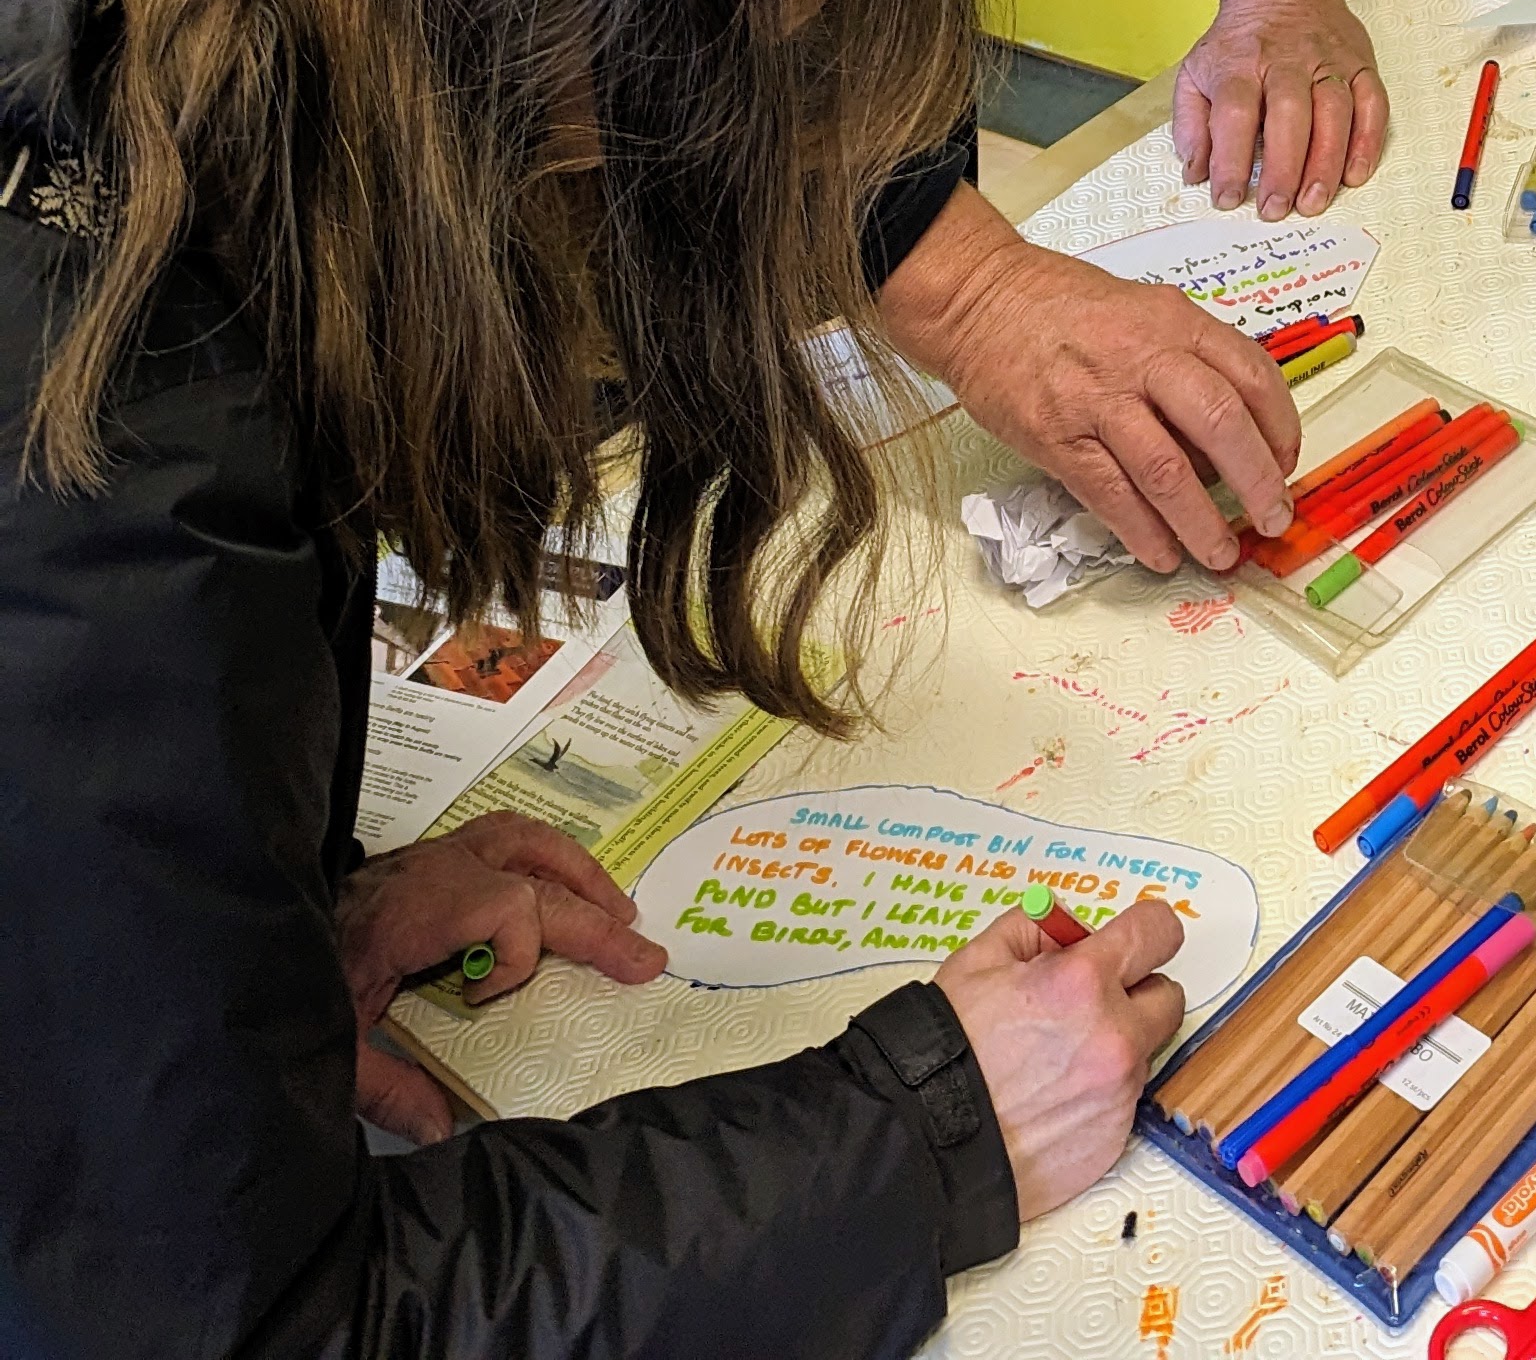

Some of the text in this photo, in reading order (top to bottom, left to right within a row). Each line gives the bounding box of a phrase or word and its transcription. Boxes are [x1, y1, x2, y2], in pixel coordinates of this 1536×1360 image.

[1212, 260, 1362, 306] composting
[1394, 501, 1429, 532] Berol
[1454, 727, 1491, 765] Berol
[790, 807, 869, 831] SMALL
[986, 833, 1034, 856] BIN
[1044, 841, 1087, 862] FOR
[1098, 851, 1203, 890] INSECTS
[730, 825, 1202, 920] LOTS OF FLOWERS ALSO WEEDS FR
[862, 871, 877, 888] I
[890, 873, 969, 903] HAVE
[694, 878, 982, 931] POND BUT I LEAVE
[674, 905, 969, 954] FOR BIRDS, ANIMA
